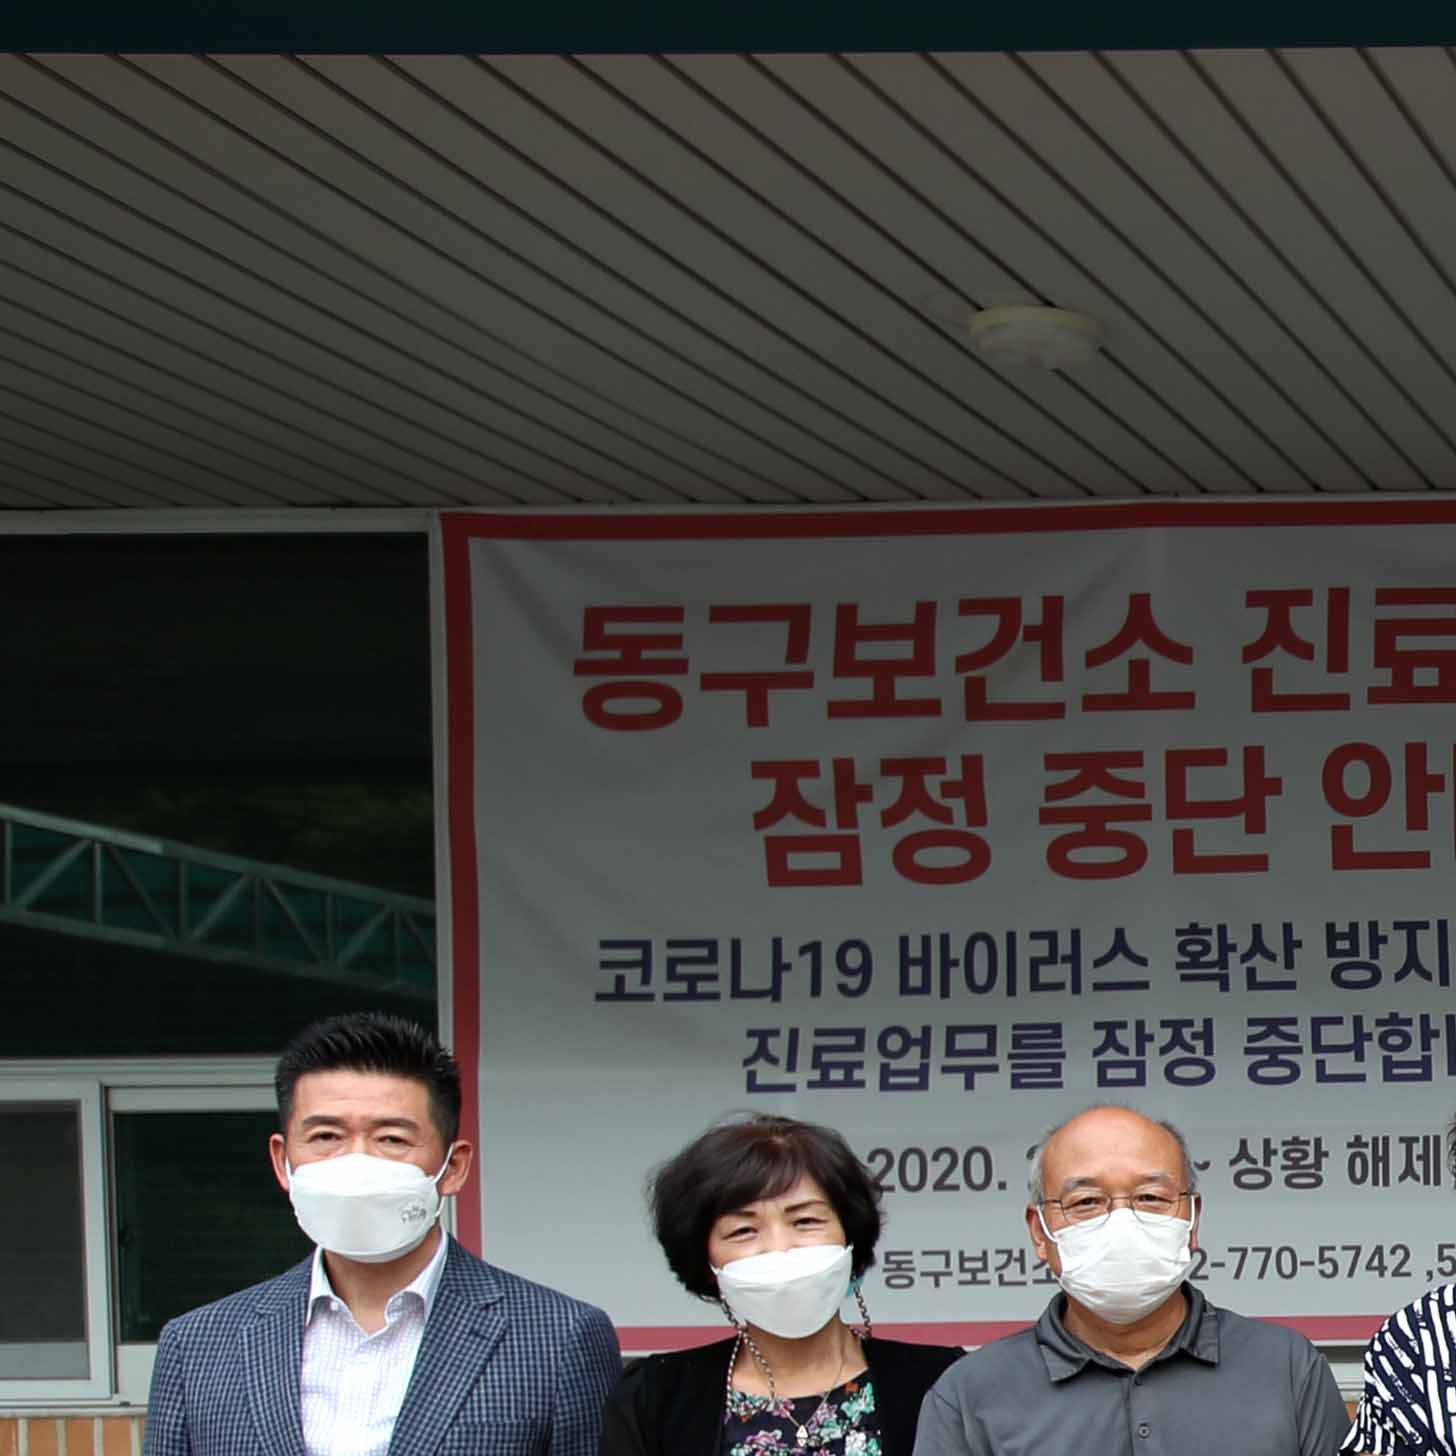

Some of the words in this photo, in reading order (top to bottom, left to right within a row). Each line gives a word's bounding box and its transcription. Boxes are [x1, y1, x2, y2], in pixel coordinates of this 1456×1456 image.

[572, 597, 1199, 731] 동구보건소
[752, 754, 989, 888] 잠정
[1040, 746, 1281, 878] 중단
[595, 935, 875, 1004] 코로나19
[899, 929, 1150, 999] 바이러스
[1175, 923, 1301, 993] 확산
[742, 1023, 1066, 1094] 진료업무를
[1092, 1018, 1215, 1086] 잠정
[1229, 1136, 1330, 1190] 상황
[1347, 1135, 1441, 1187] 해제
